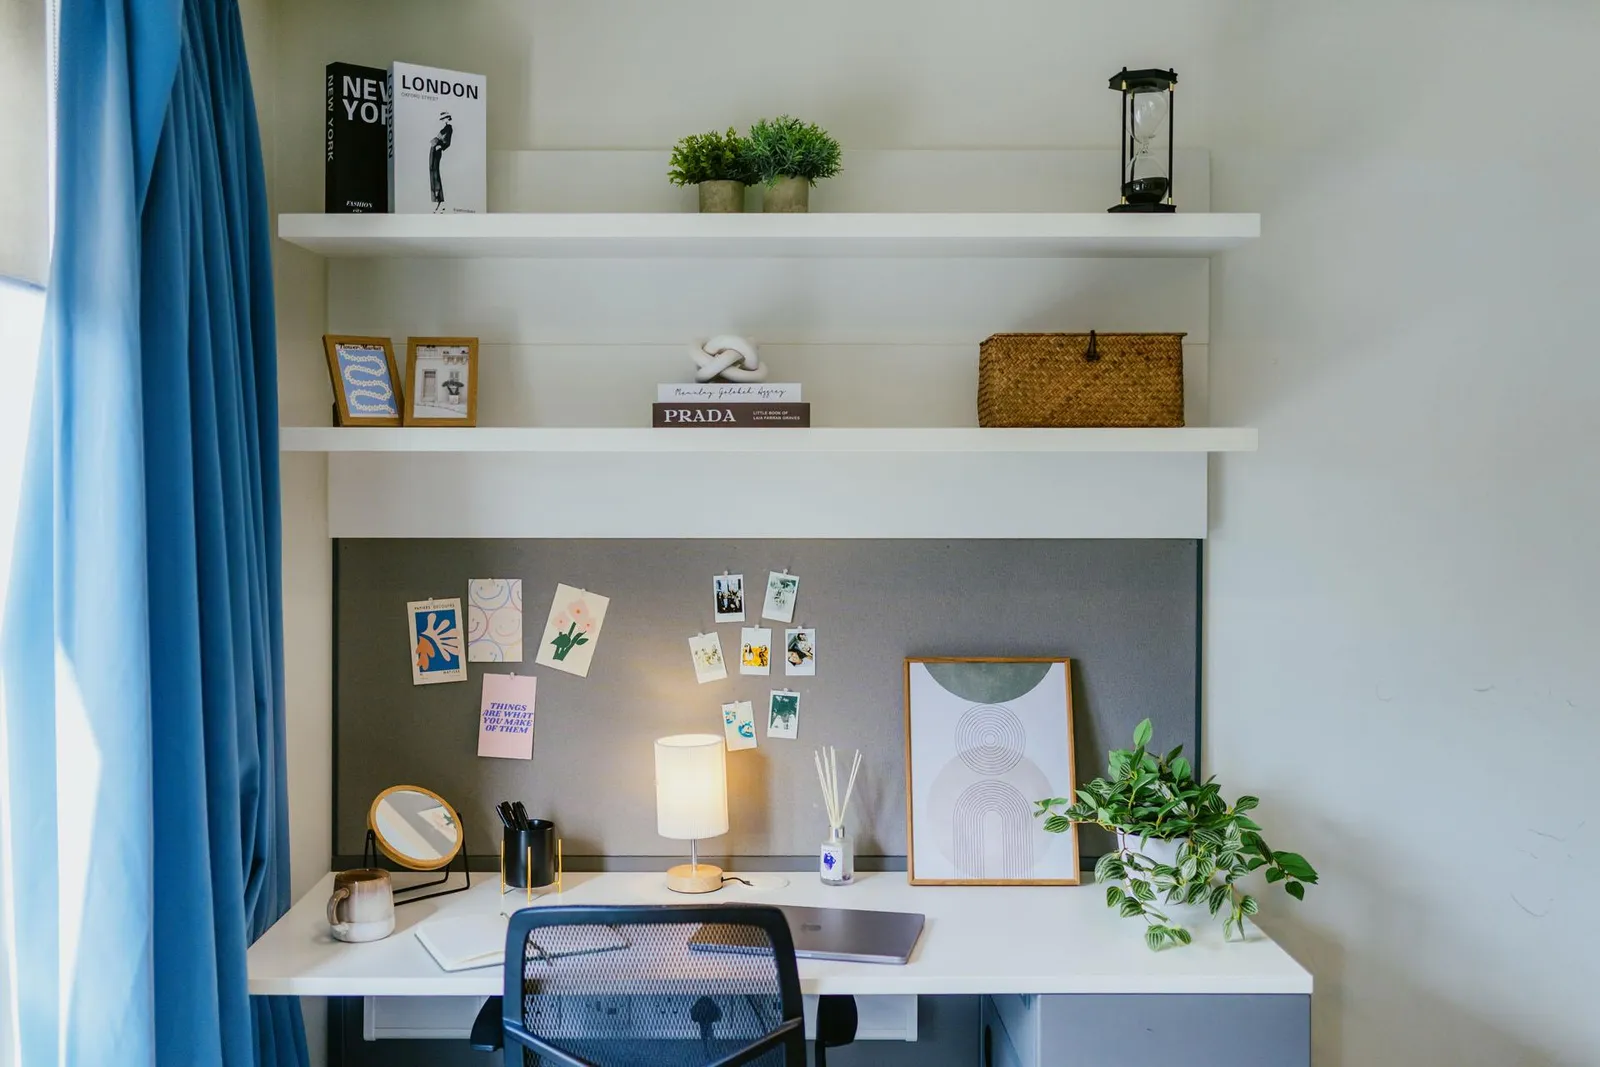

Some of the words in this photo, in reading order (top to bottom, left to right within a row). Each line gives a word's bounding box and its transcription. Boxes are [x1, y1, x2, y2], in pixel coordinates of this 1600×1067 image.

[402, 74, 478, 100] LONDON
[400, 91, 421, 100] OXFORD
[345, 200, 373, 208] FASHION
[664, 409, 736, 422] PRADA
[490, 703, 527, 711] THINGS
[504, 711, 533, 719] WHAT
